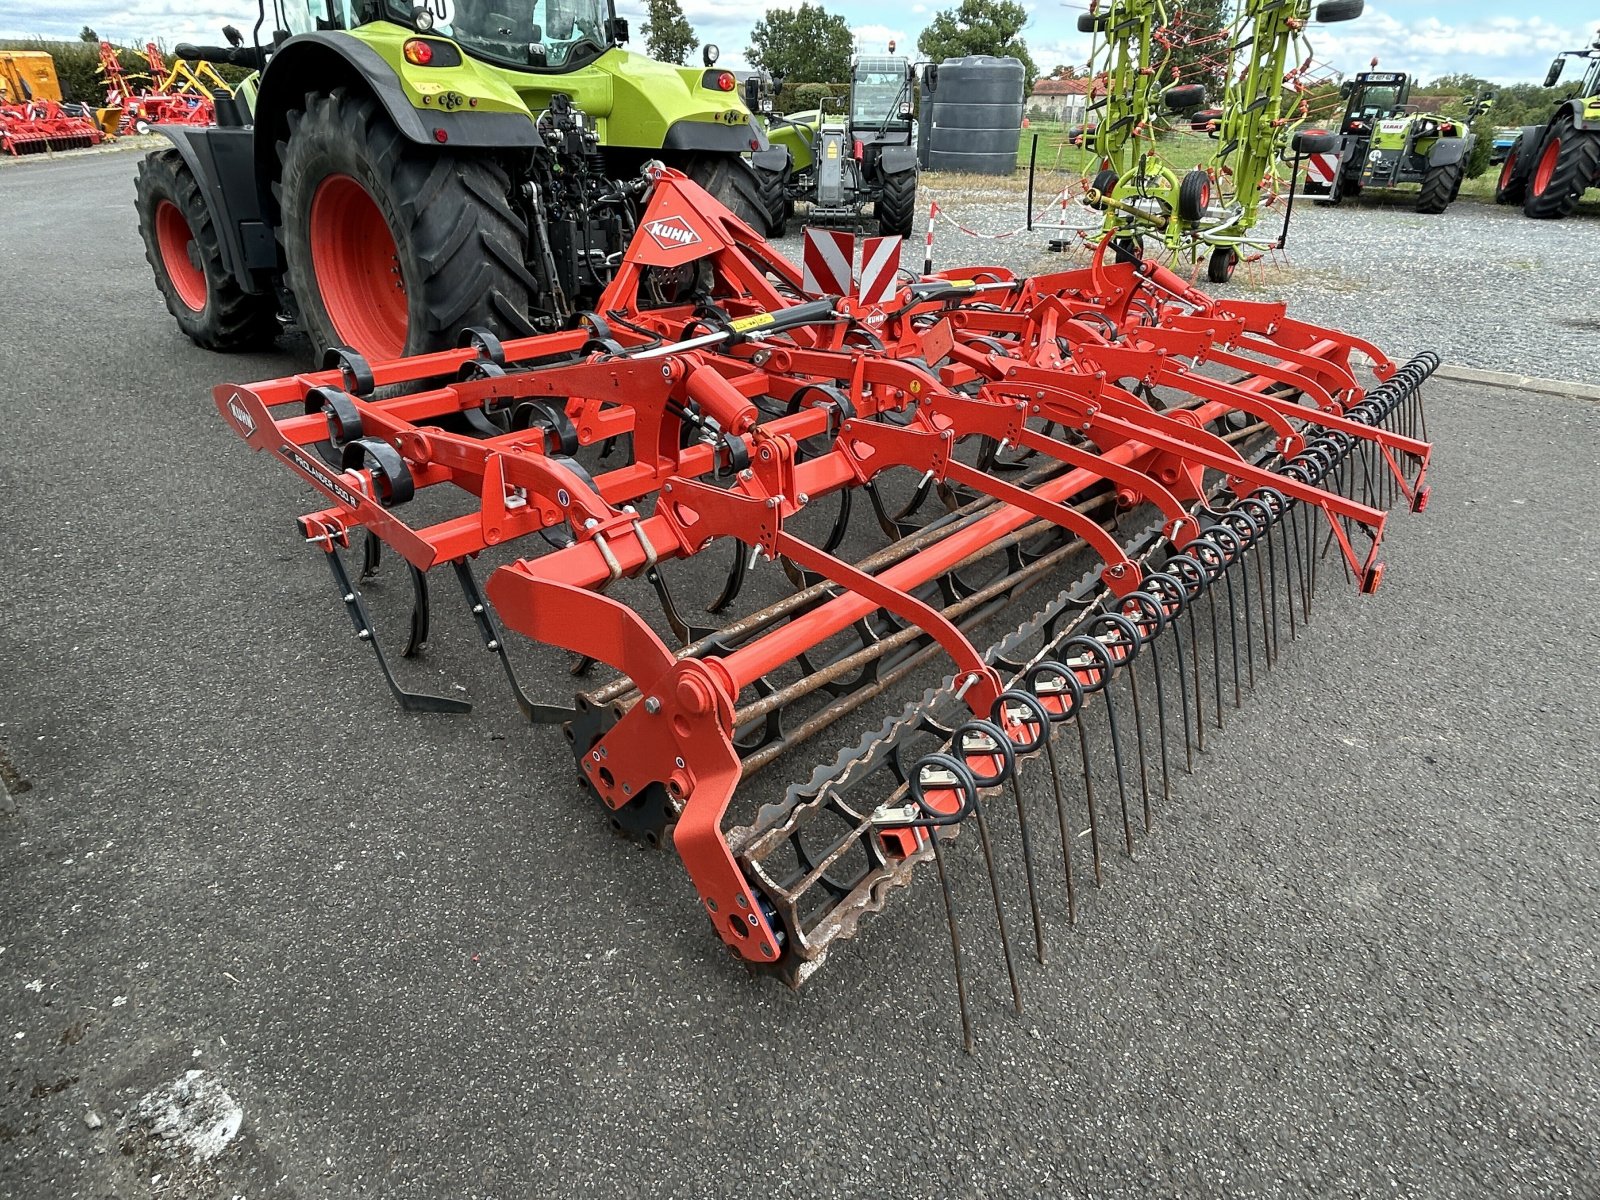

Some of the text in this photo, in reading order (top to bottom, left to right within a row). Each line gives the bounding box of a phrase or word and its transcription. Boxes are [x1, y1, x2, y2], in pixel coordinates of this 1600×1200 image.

[650, 222, 694, 243] KUHN
[230, 402, 254, 430] KUHN
[294, 453, 357, 508] PROLANDER 500 R
